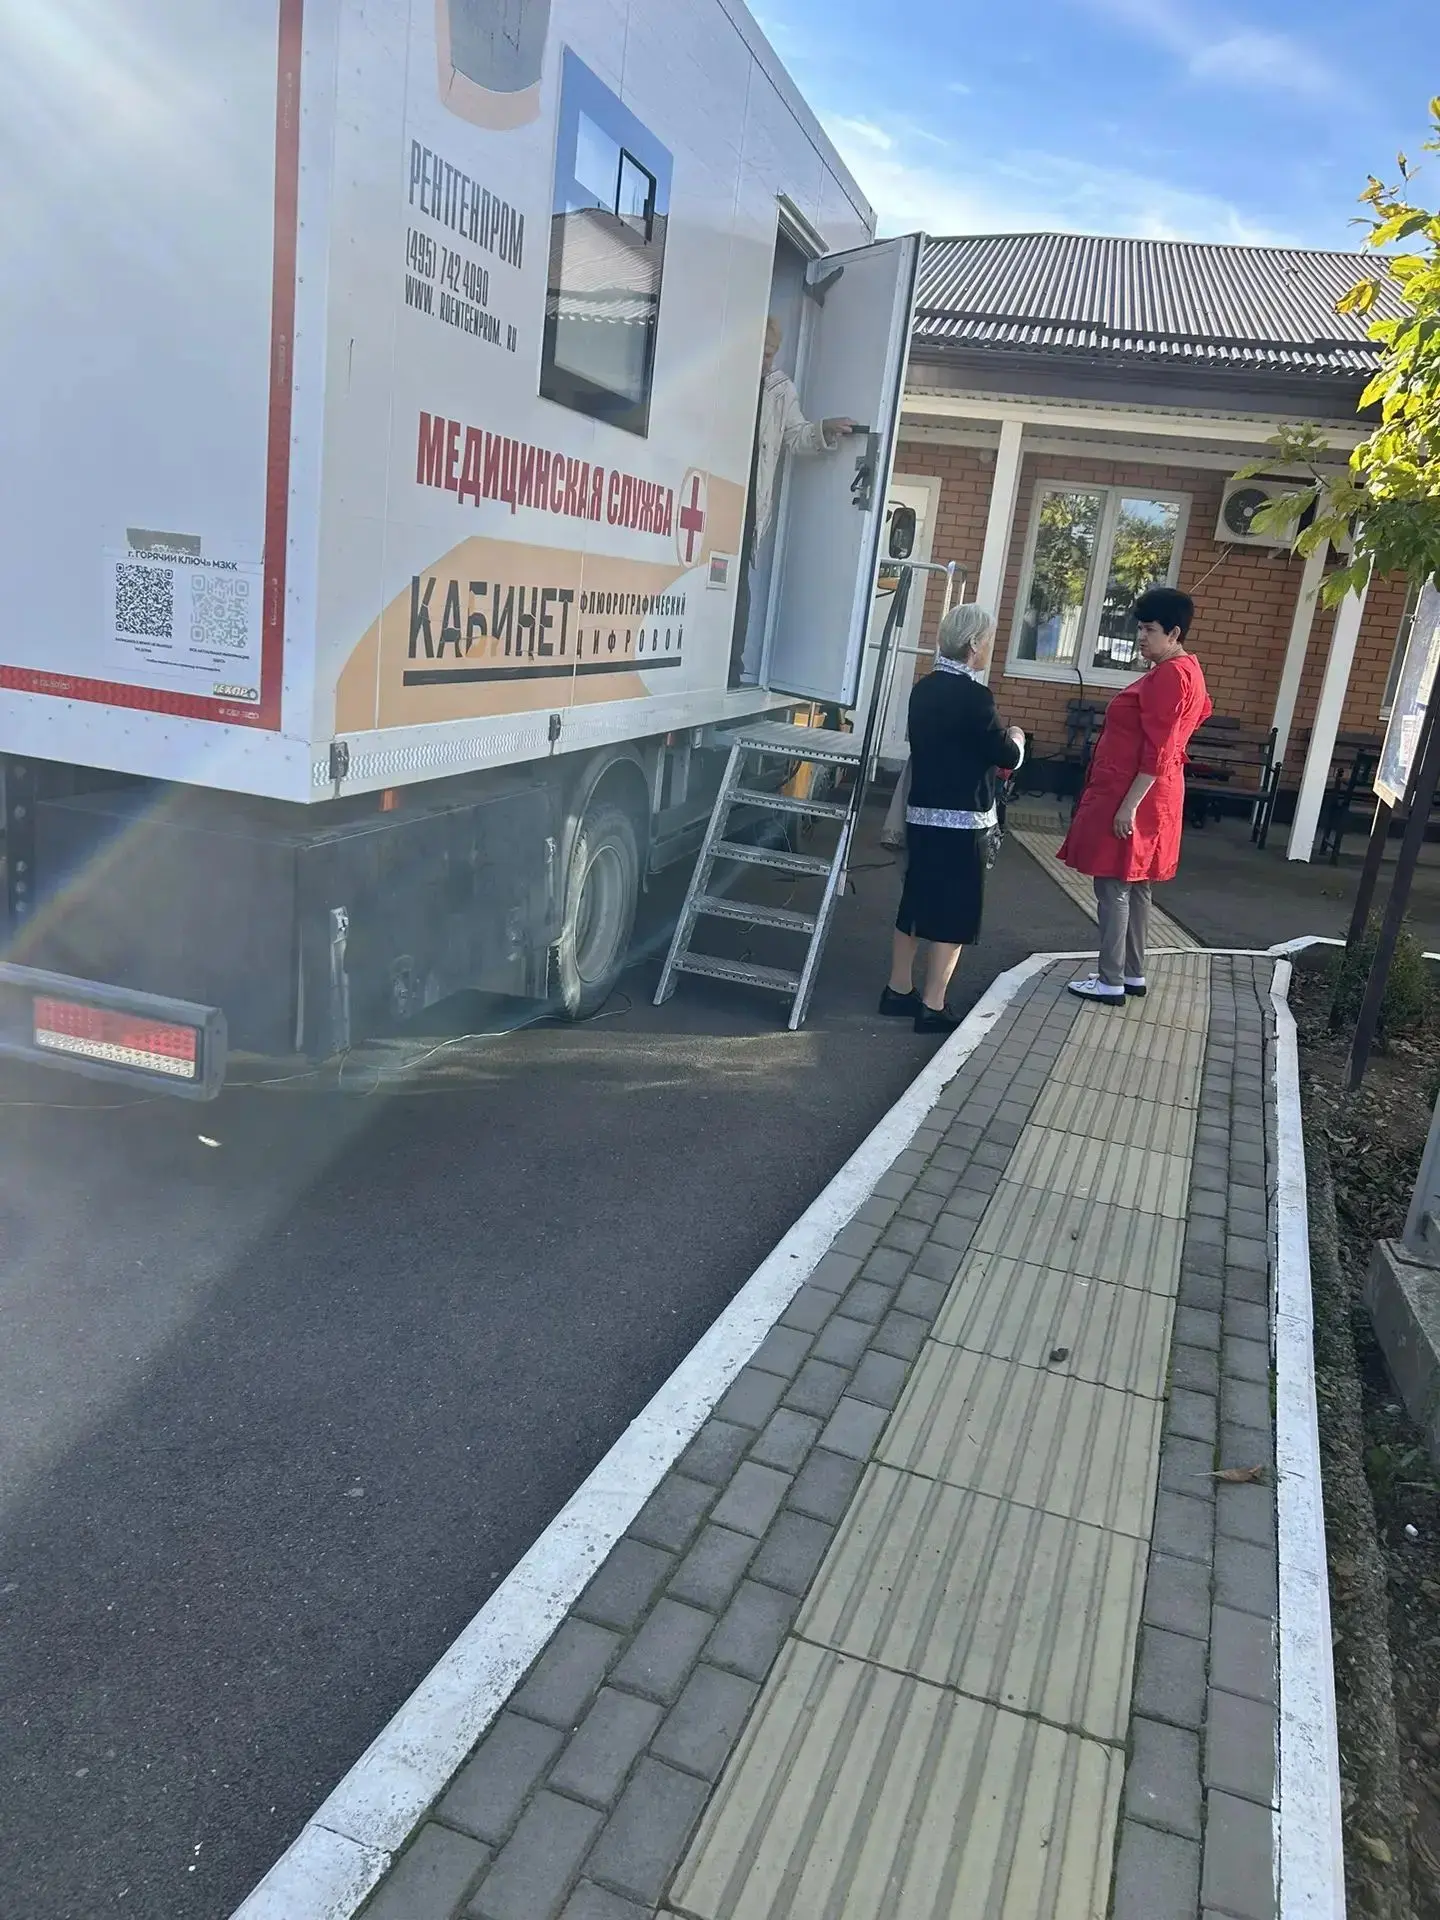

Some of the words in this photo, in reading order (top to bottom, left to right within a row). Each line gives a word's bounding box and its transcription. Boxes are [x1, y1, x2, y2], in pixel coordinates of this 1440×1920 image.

[408, 138, 525, 269] РЕНТГЕНПРОМ
[405, 227, 437, 279] (495)
[440, 246, 461, 293] 742
[463, 259, 489, 307] 4090
[416, 411, 605, 522] МЕДИЦИНСКАЯ
[606, 469, 674, 537] СЛУЖБА
[408, 575, 575, 659] КАБИНЕТ
[576, 623, 684, 660] ЦИФРОВОЙ
[579, 591, 687, 617] ФЛЮОРОГРАФИЧЕСКИЙ
